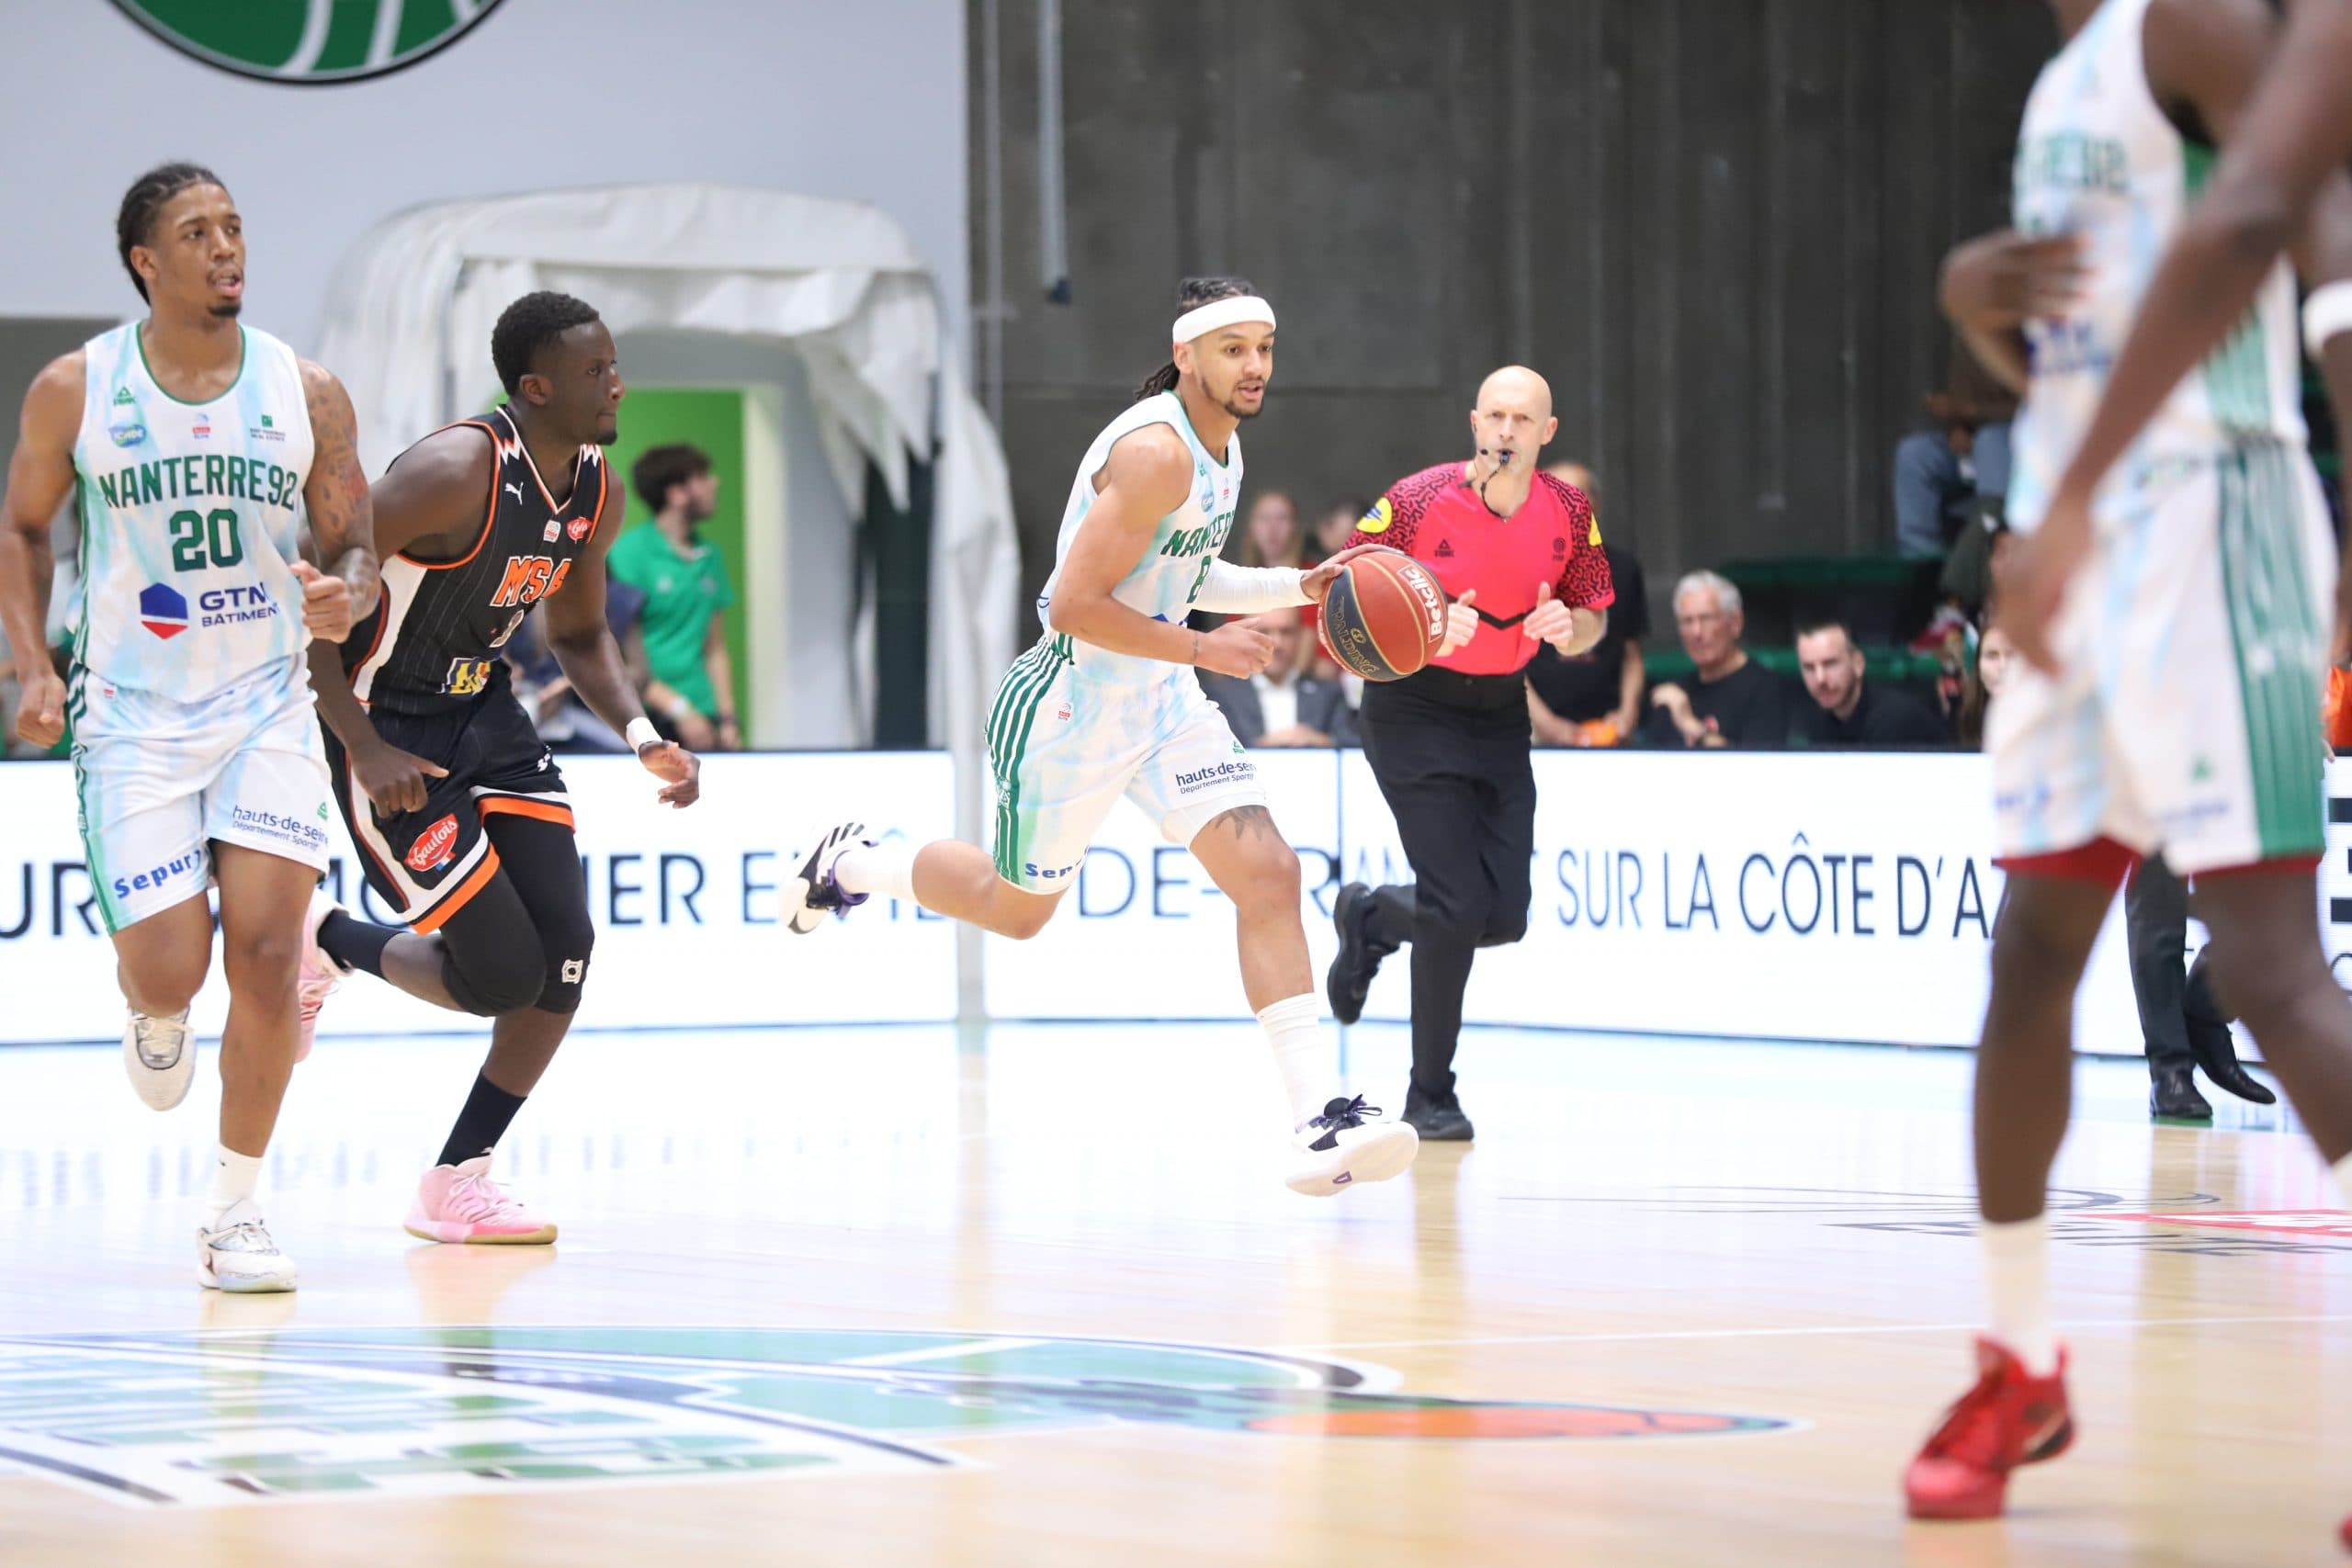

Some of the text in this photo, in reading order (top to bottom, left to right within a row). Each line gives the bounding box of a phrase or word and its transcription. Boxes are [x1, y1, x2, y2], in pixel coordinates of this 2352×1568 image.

[98, 454, 299, 512] NANTERRE92
[169, 508, 243, 572] 20
[199, 581, 269, 612] GTN
[413, 820, 459, 866] Gaulois
[1557, 848, 1643, 929] SUR
[1663, 851, 1720, 931] LA
[1738, 830, 1875, 935] CÔTE
[1896, 854, 1999, 940] D'A
